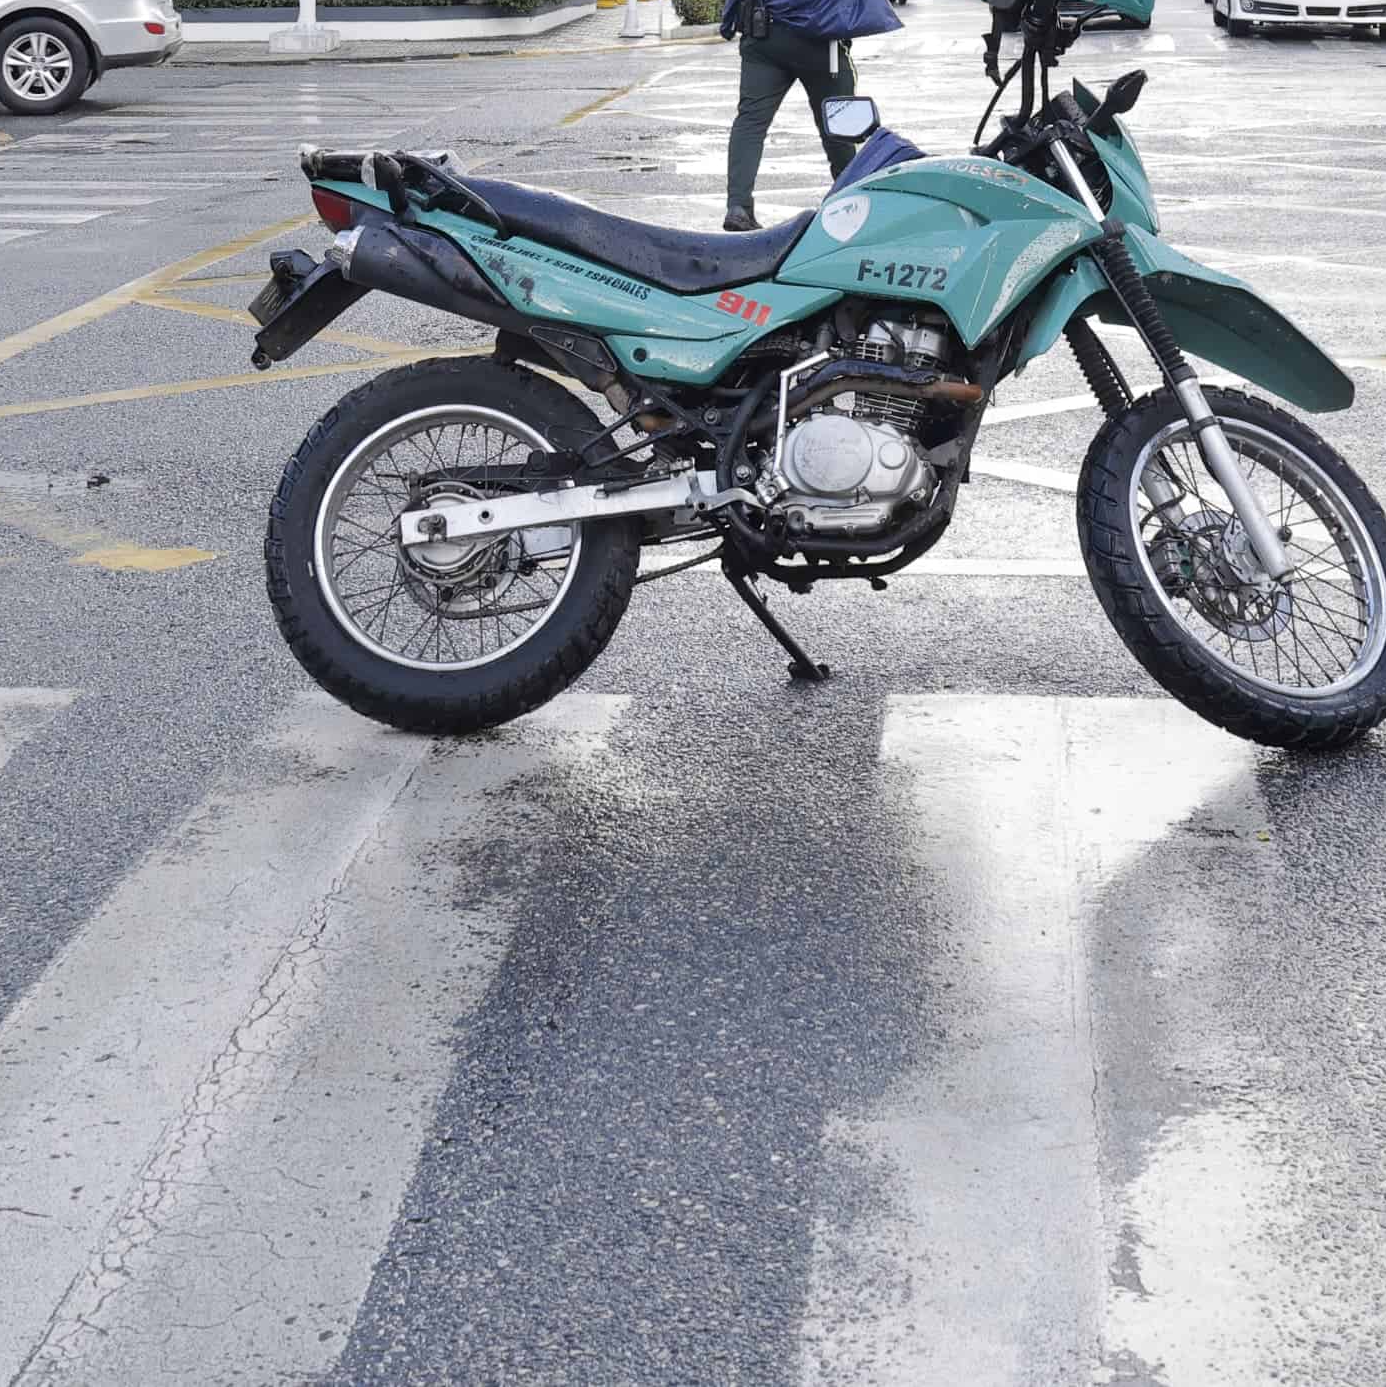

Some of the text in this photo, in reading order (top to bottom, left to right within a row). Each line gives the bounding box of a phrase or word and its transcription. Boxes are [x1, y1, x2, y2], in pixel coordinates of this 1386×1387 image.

[585, 268, 652, 301] ESPECIALES
[857, 260, 948, 291] F-1272
[716, 291, 772, 326] 911
